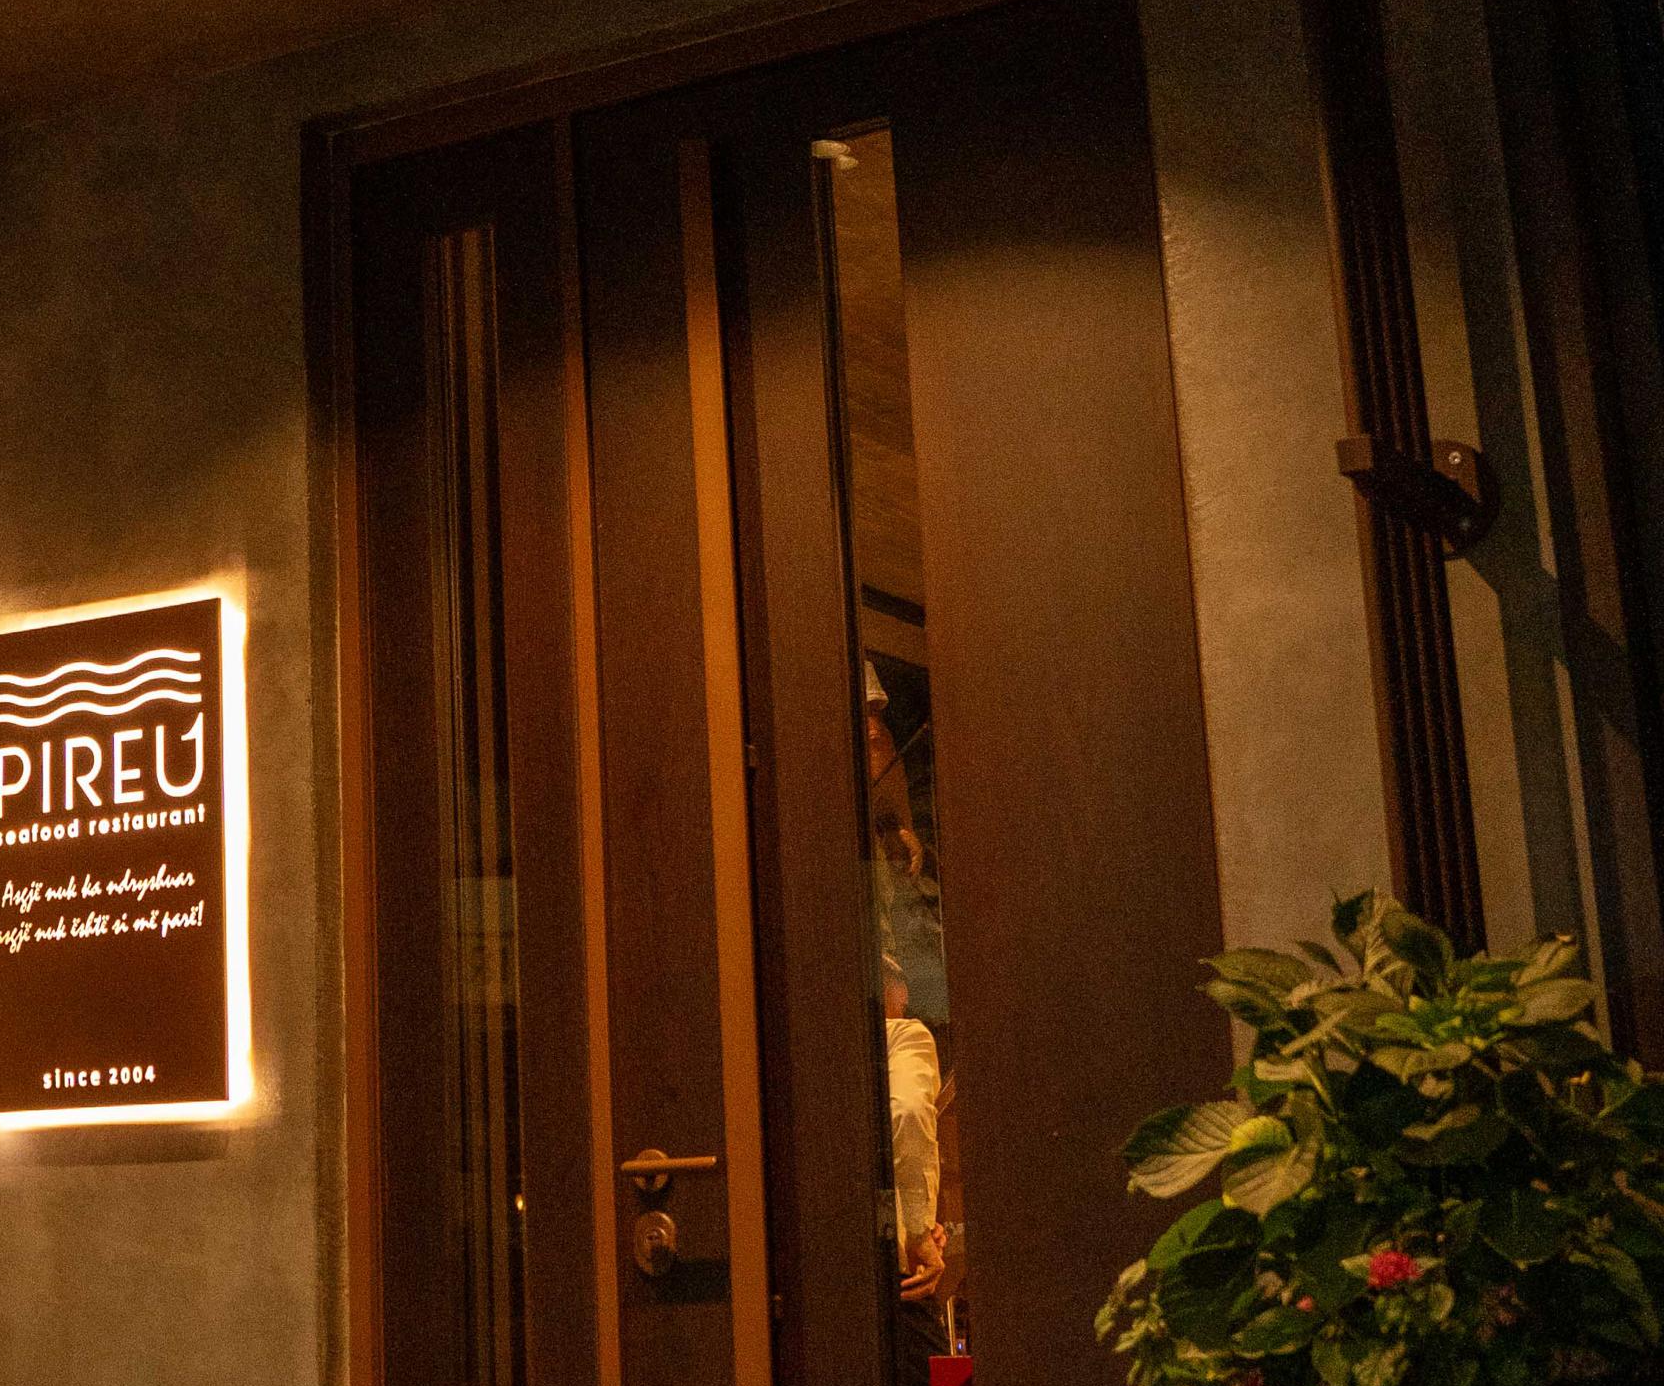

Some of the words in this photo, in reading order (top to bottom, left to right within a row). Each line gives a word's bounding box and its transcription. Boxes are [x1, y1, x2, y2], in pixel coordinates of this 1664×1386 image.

[88, 802, 206, 837] restaurant
[1, 879, 44, 914] Asgjë
[44, 875, 78, 902] nuk
[80, 873, 103, 899] ka
[105, 863, 196, 902] ndryshuar
[33, 915, 67, 943] nuk
[69, 910, 111, 939] është
[111, 912, 130, 936] si
[132, 909, 160, 932] më
[160, 899, 205, 938] parë!
[42, 1067, 101, 1090] since
[108, 1064, 156, 1086] 2004
